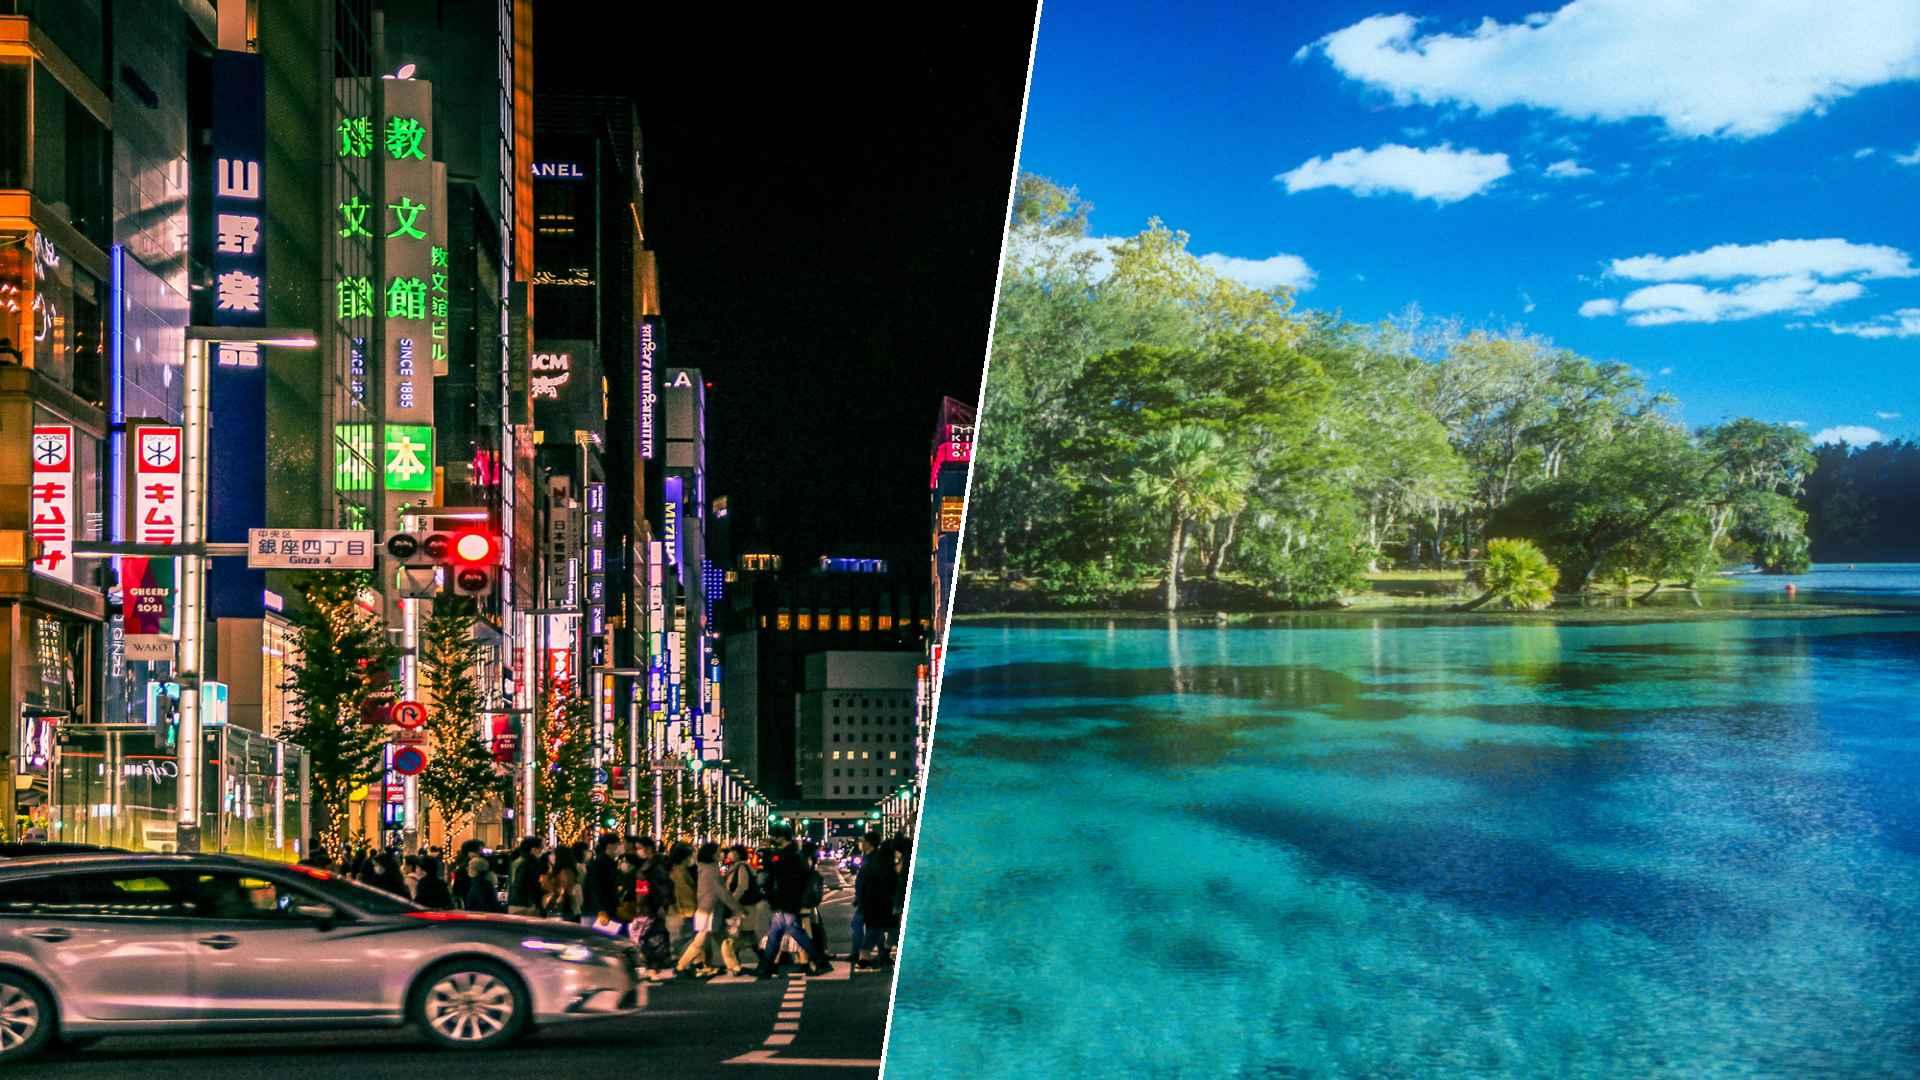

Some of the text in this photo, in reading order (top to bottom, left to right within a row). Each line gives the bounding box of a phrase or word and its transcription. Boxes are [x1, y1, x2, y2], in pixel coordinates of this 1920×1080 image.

[385, 116, 427, 319] 教文館
[400, 338, 413, 408] SINCE 1885
[386, 436, 426, 480] 本
[258, 539, 365, 556] 銀座四丁目
[289, 555, 332, 565] Ginza 4
[130, 587, 169, 597] CHEERS
[137, 604, 162, 612] 2021
[134, 643, 168, 652] WAKO
